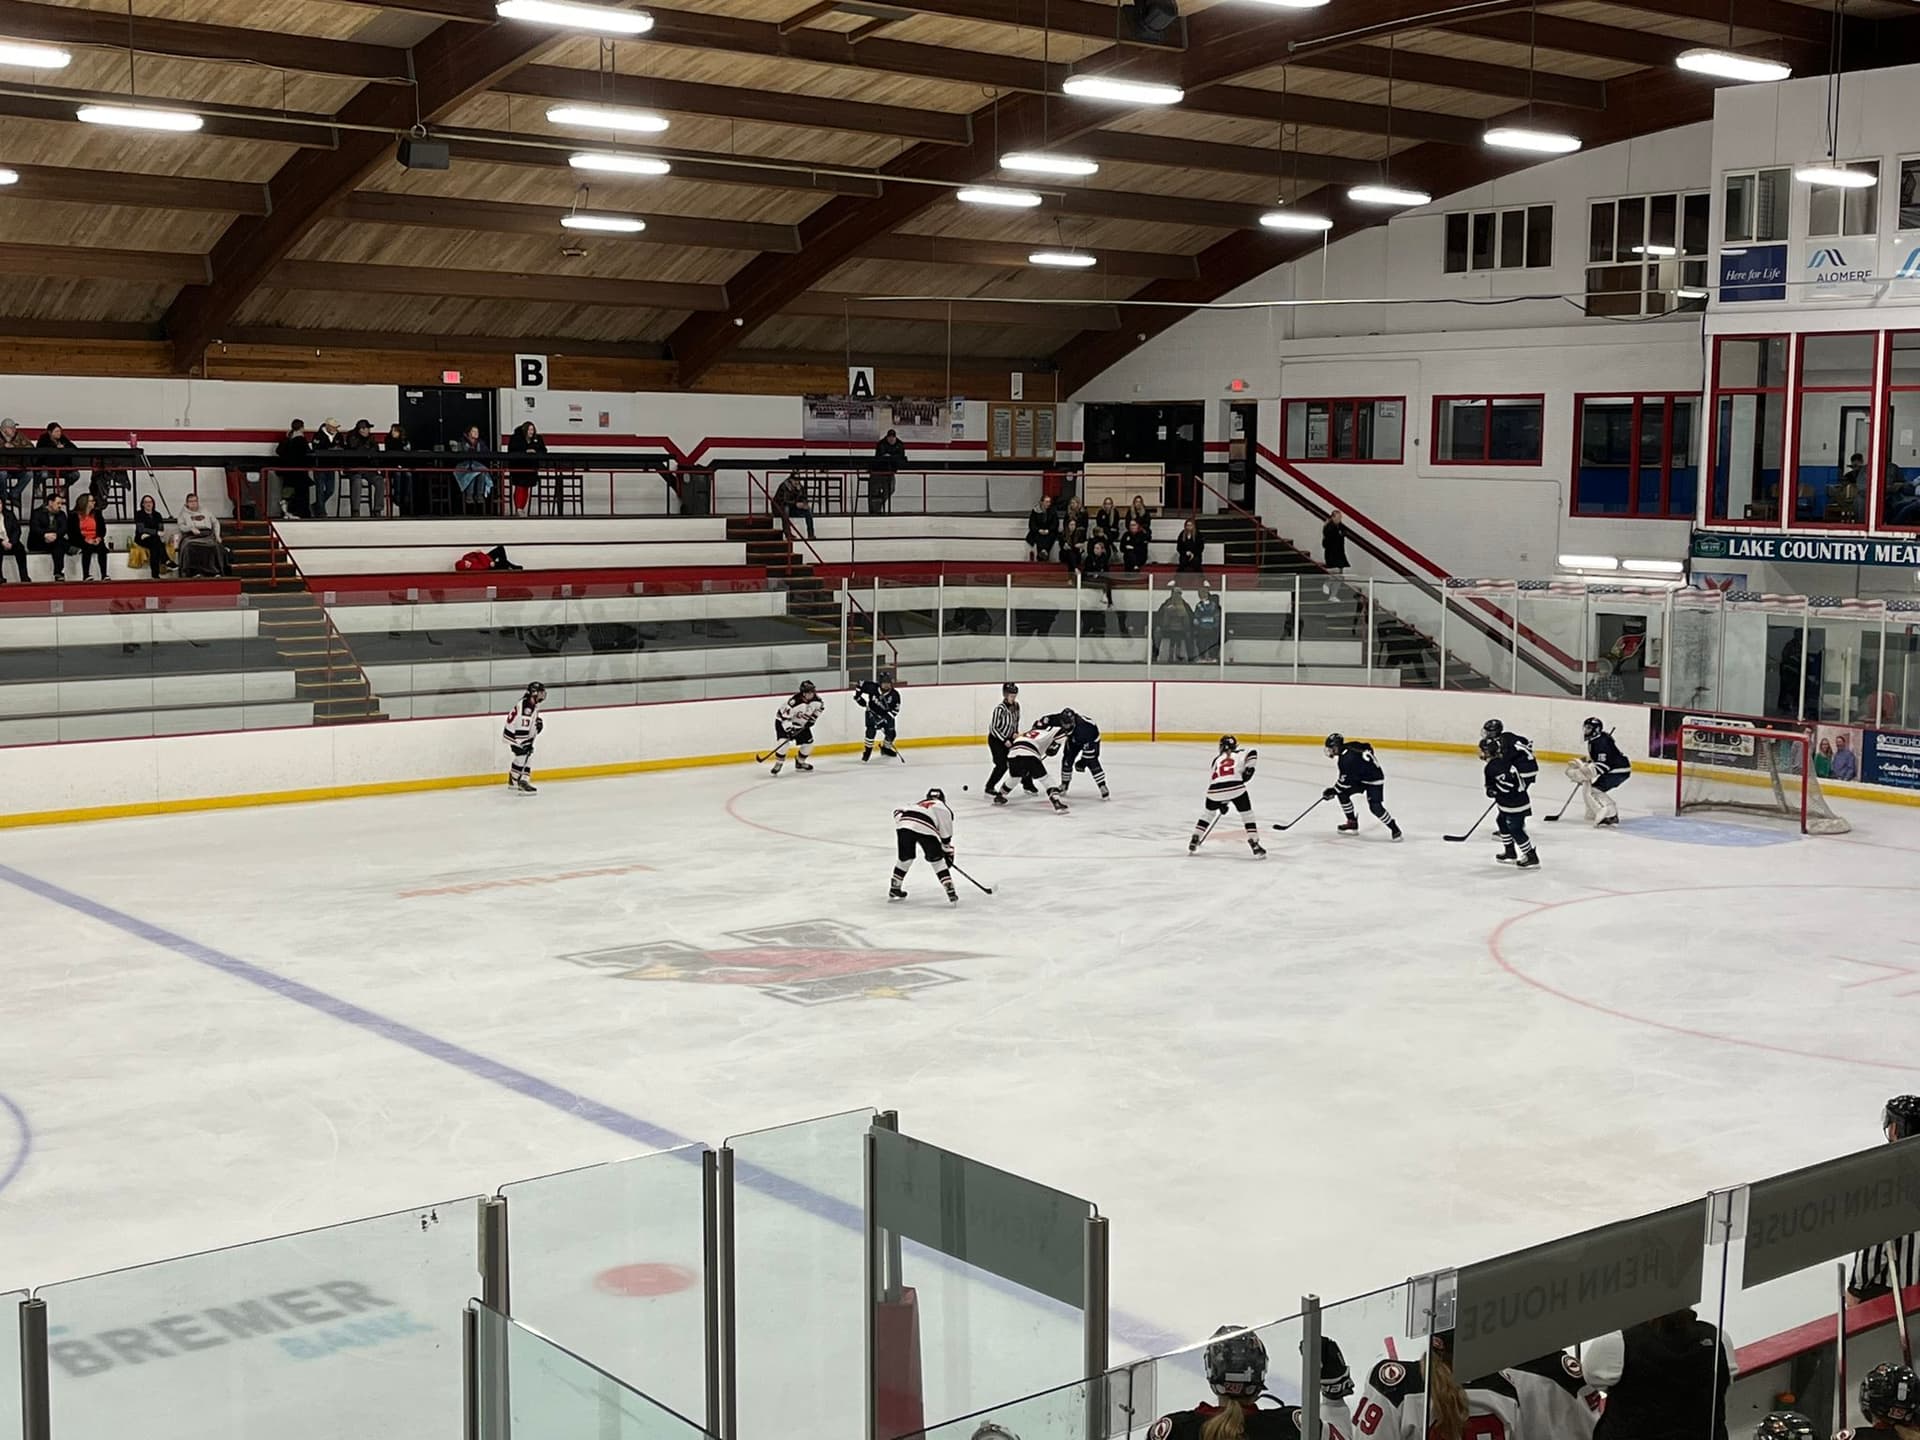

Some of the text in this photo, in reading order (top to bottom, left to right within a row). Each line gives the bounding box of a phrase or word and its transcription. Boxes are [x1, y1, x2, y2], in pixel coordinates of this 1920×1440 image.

[1726, 267, 1780, 281] Here for Life
[521, 358, 543, 387] B
[851, 370, 872, 397] A
[1729, 539, 1775, 558] LAKE
[1780, 540, 1868, 562] COUNTRY
[50, 1279, 396, 1378] BREMER
[1352, 1397, 1383, 1436] 19
